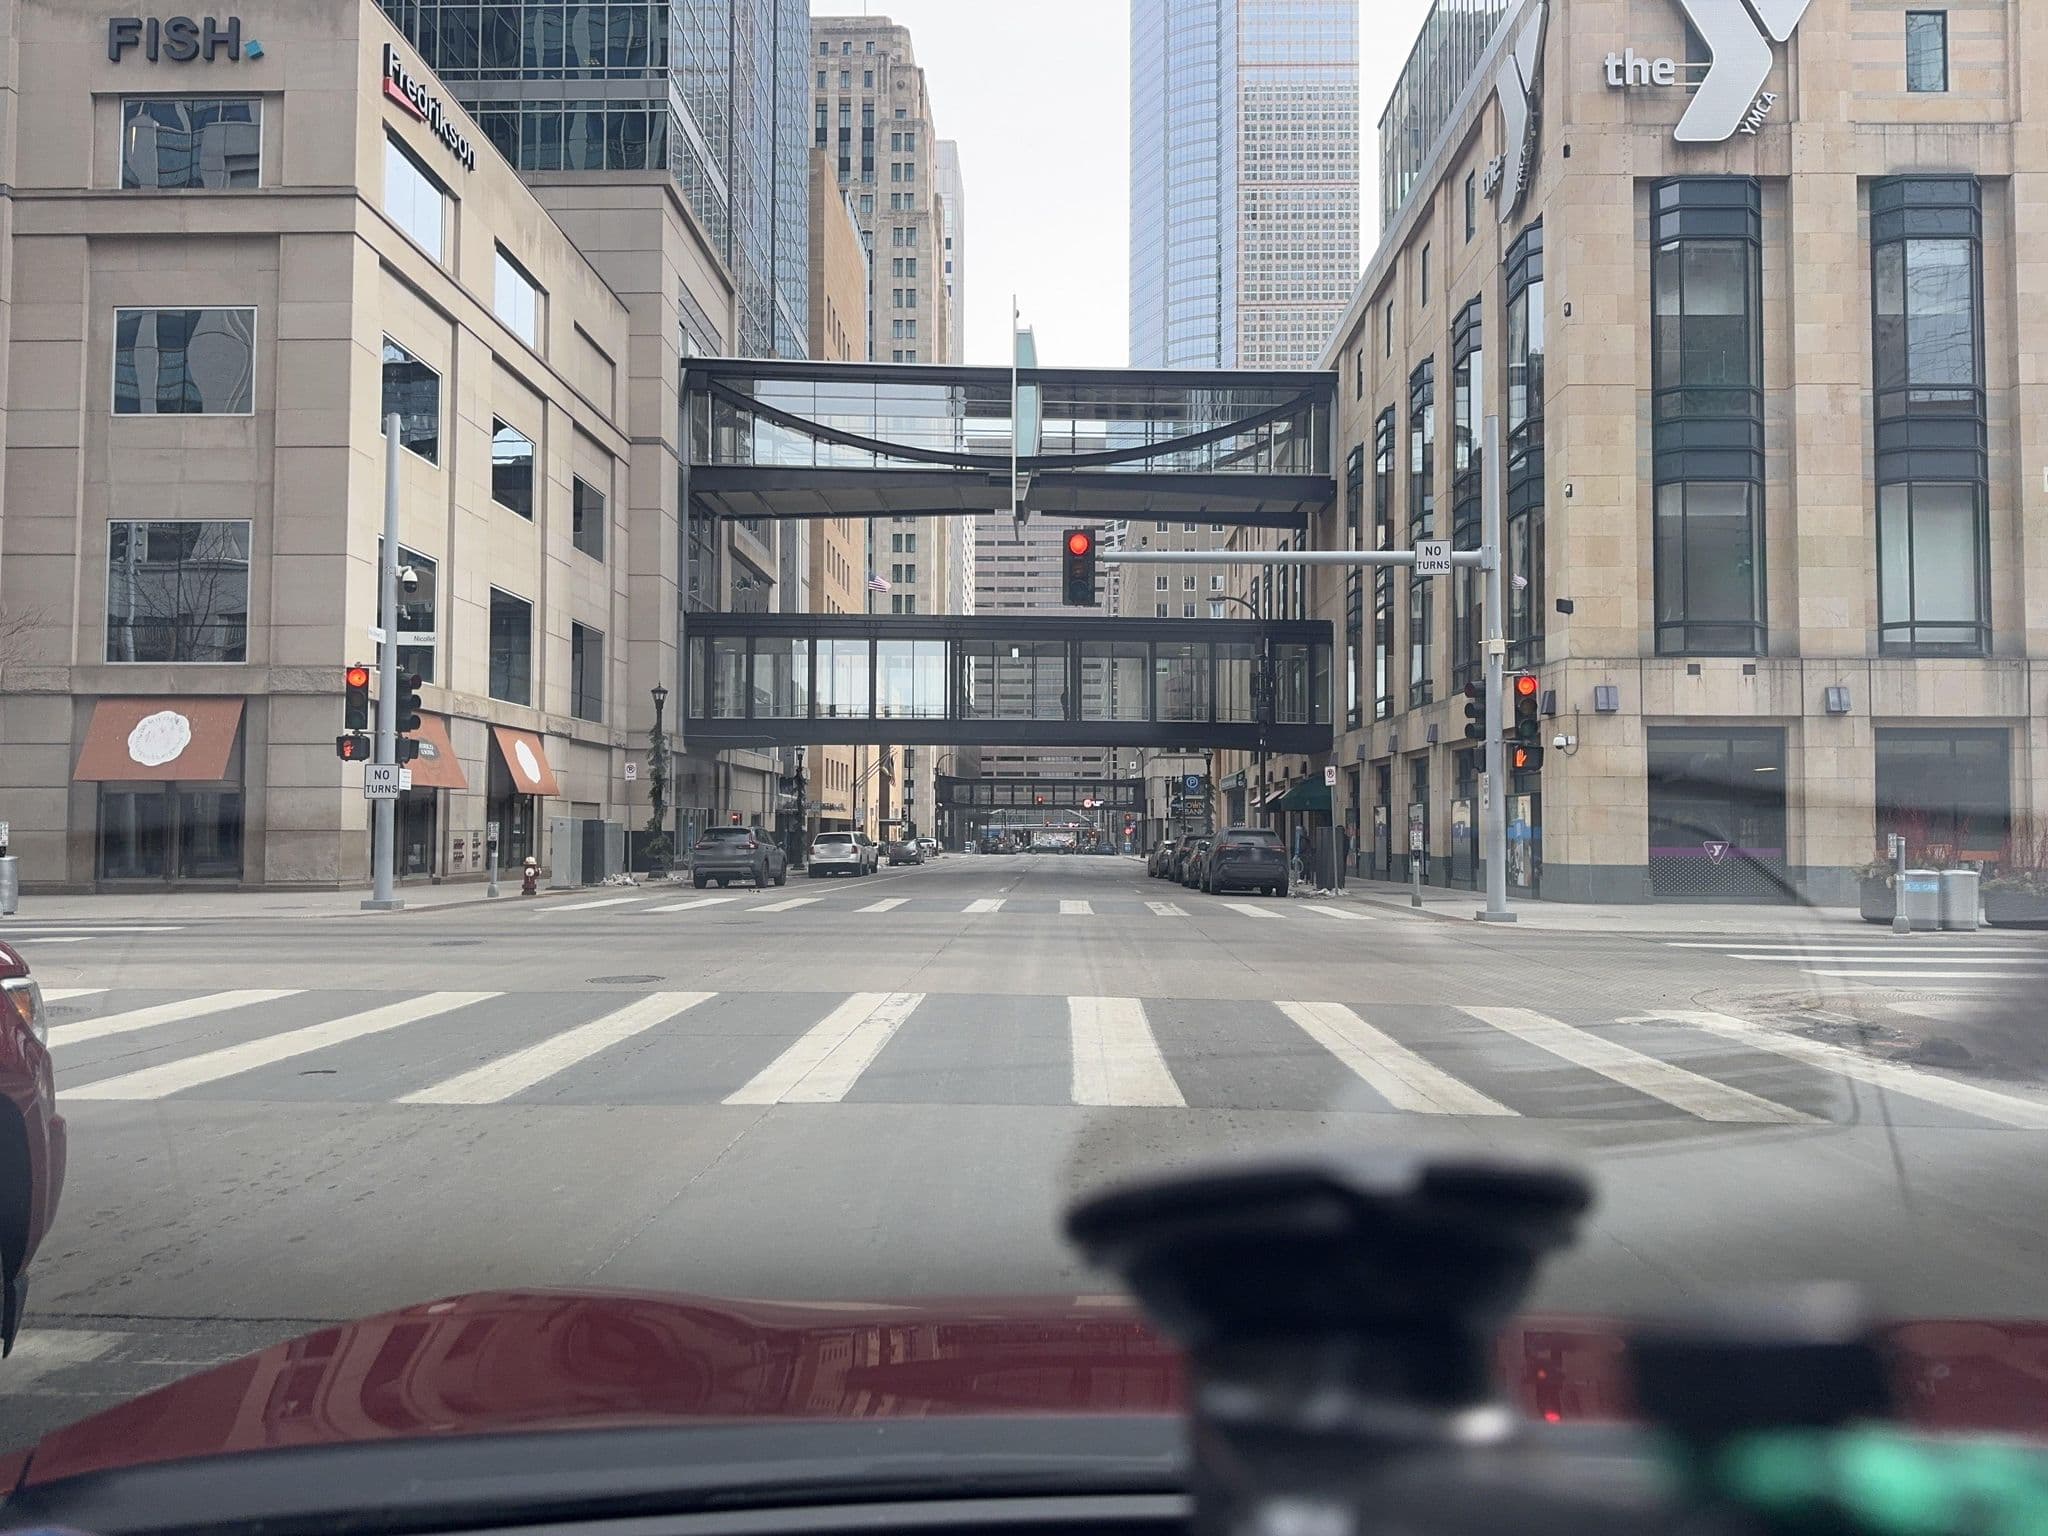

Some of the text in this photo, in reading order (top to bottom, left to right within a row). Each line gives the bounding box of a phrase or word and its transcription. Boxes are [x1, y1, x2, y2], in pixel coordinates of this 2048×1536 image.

[1604, 48, 1676, 87] the
[384, 43, 476, 173] Fredrikson
[1740, 91, 1778, 136] YMCA
[1425, 545, 1442, 556] NO
[1417, 560, 1450, 570] TURNS
[374, 769, 390, 780] NO
[366, 784, 398, 794] TURNS
